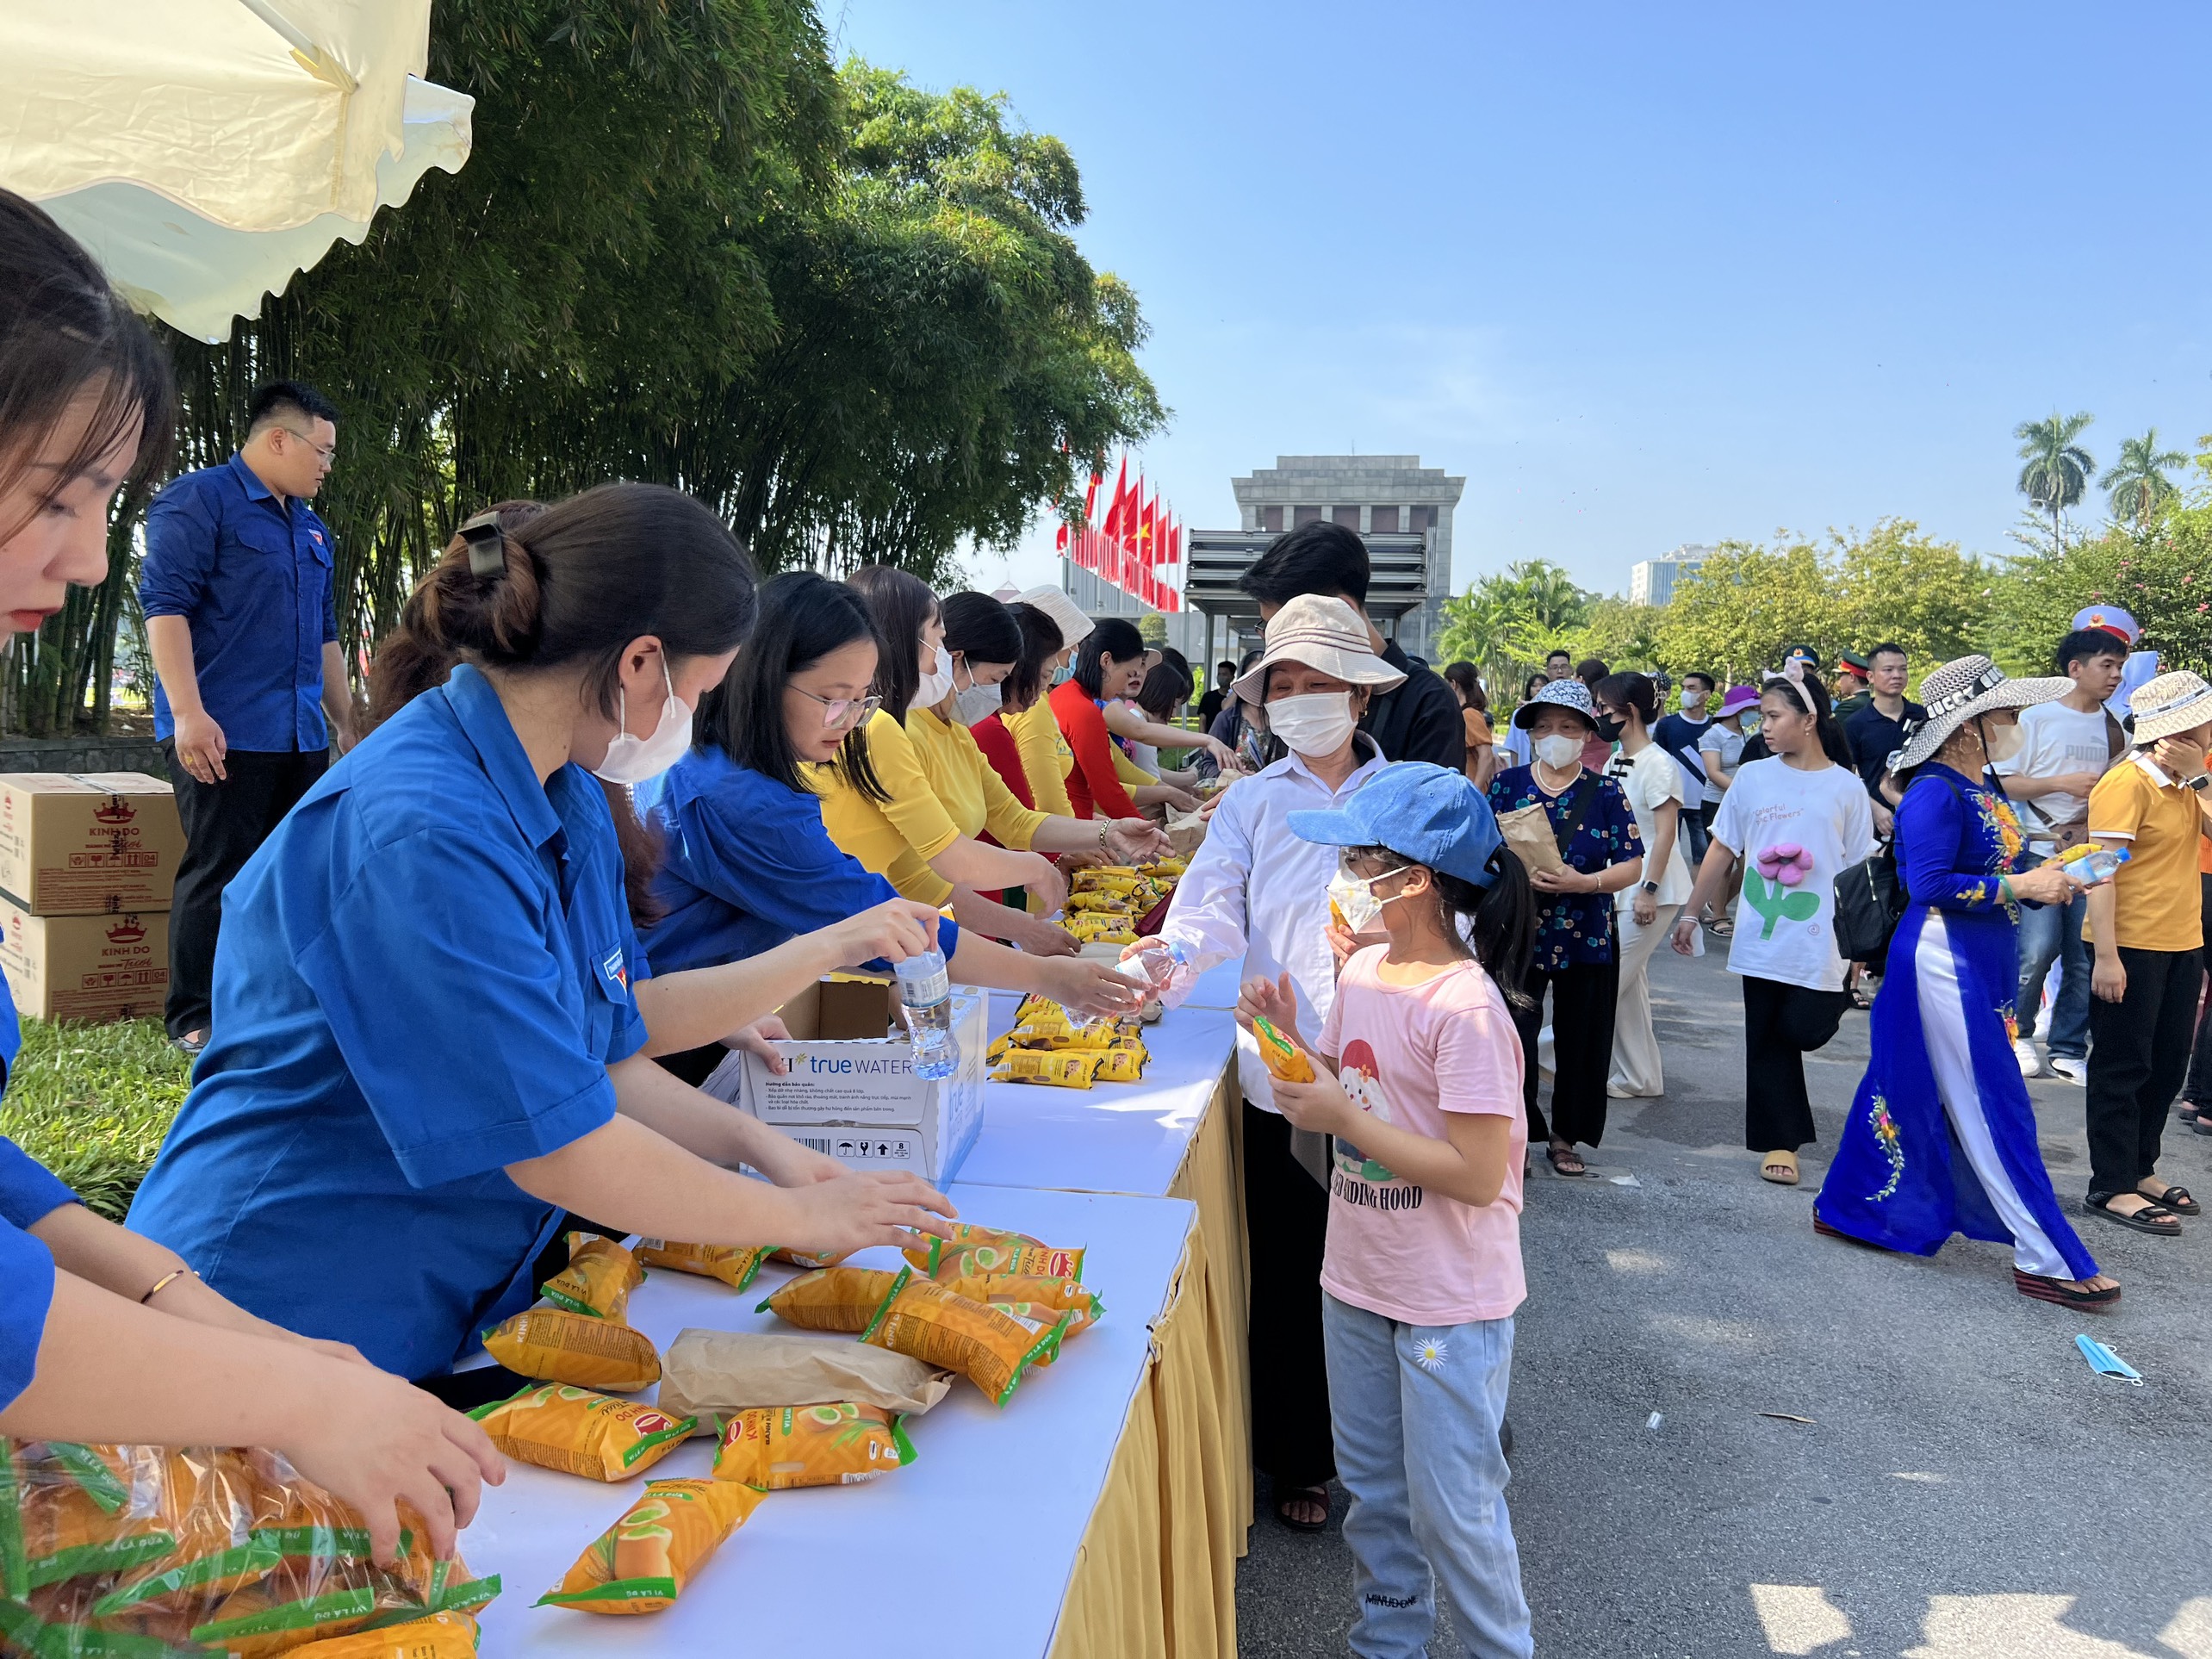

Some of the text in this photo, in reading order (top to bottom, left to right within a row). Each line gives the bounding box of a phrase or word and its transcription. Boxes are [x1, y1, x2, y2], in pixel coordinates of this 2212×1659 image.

[2066, 744, 2108, 762] PUMA
[102, 948, 129, 957] KINH
[810, 1056, 852, 1073] true
[854, 1059, 912, 1074] WATER
[1380, 1185, 1422, 1210] HOOD
[886, 1322, 896, 1347] KINH
[615, 1413, 632, 1421] DO
